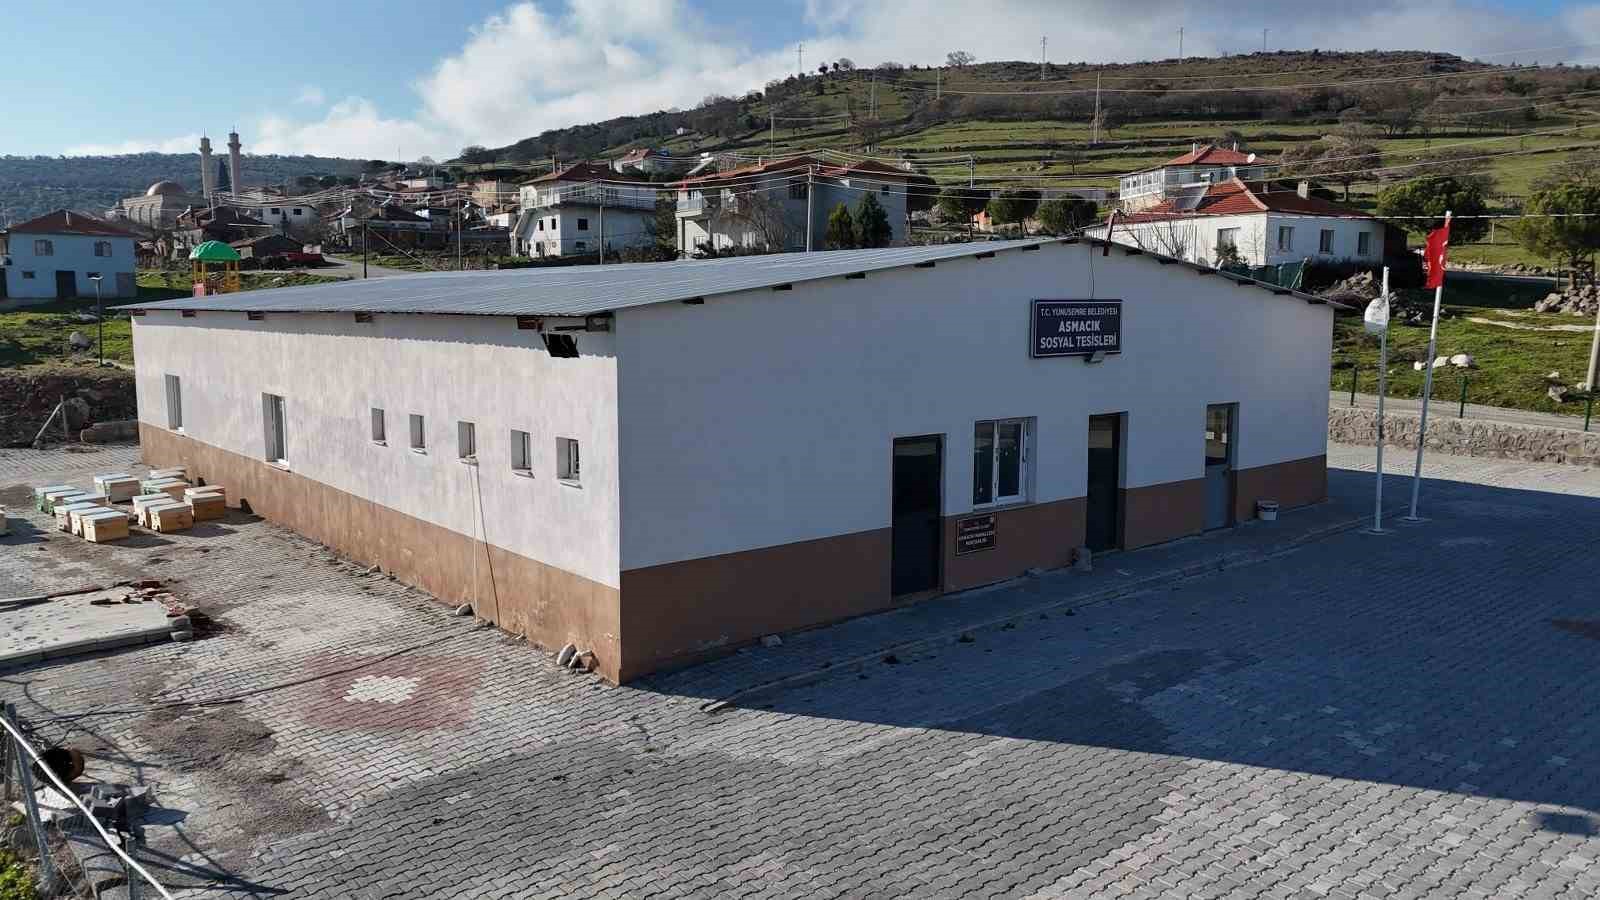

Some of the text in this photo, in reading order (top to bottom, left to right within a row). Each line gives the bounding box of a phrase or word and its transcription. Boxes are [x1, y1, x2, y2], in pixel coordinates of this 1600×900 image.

[1052, 307, 1087, 316] YUNUSEMRE
[1059, 320, 1100, 332] ASMACIK
[1040, 332, 1117, 349] SOSYAL TESİSLERİ
